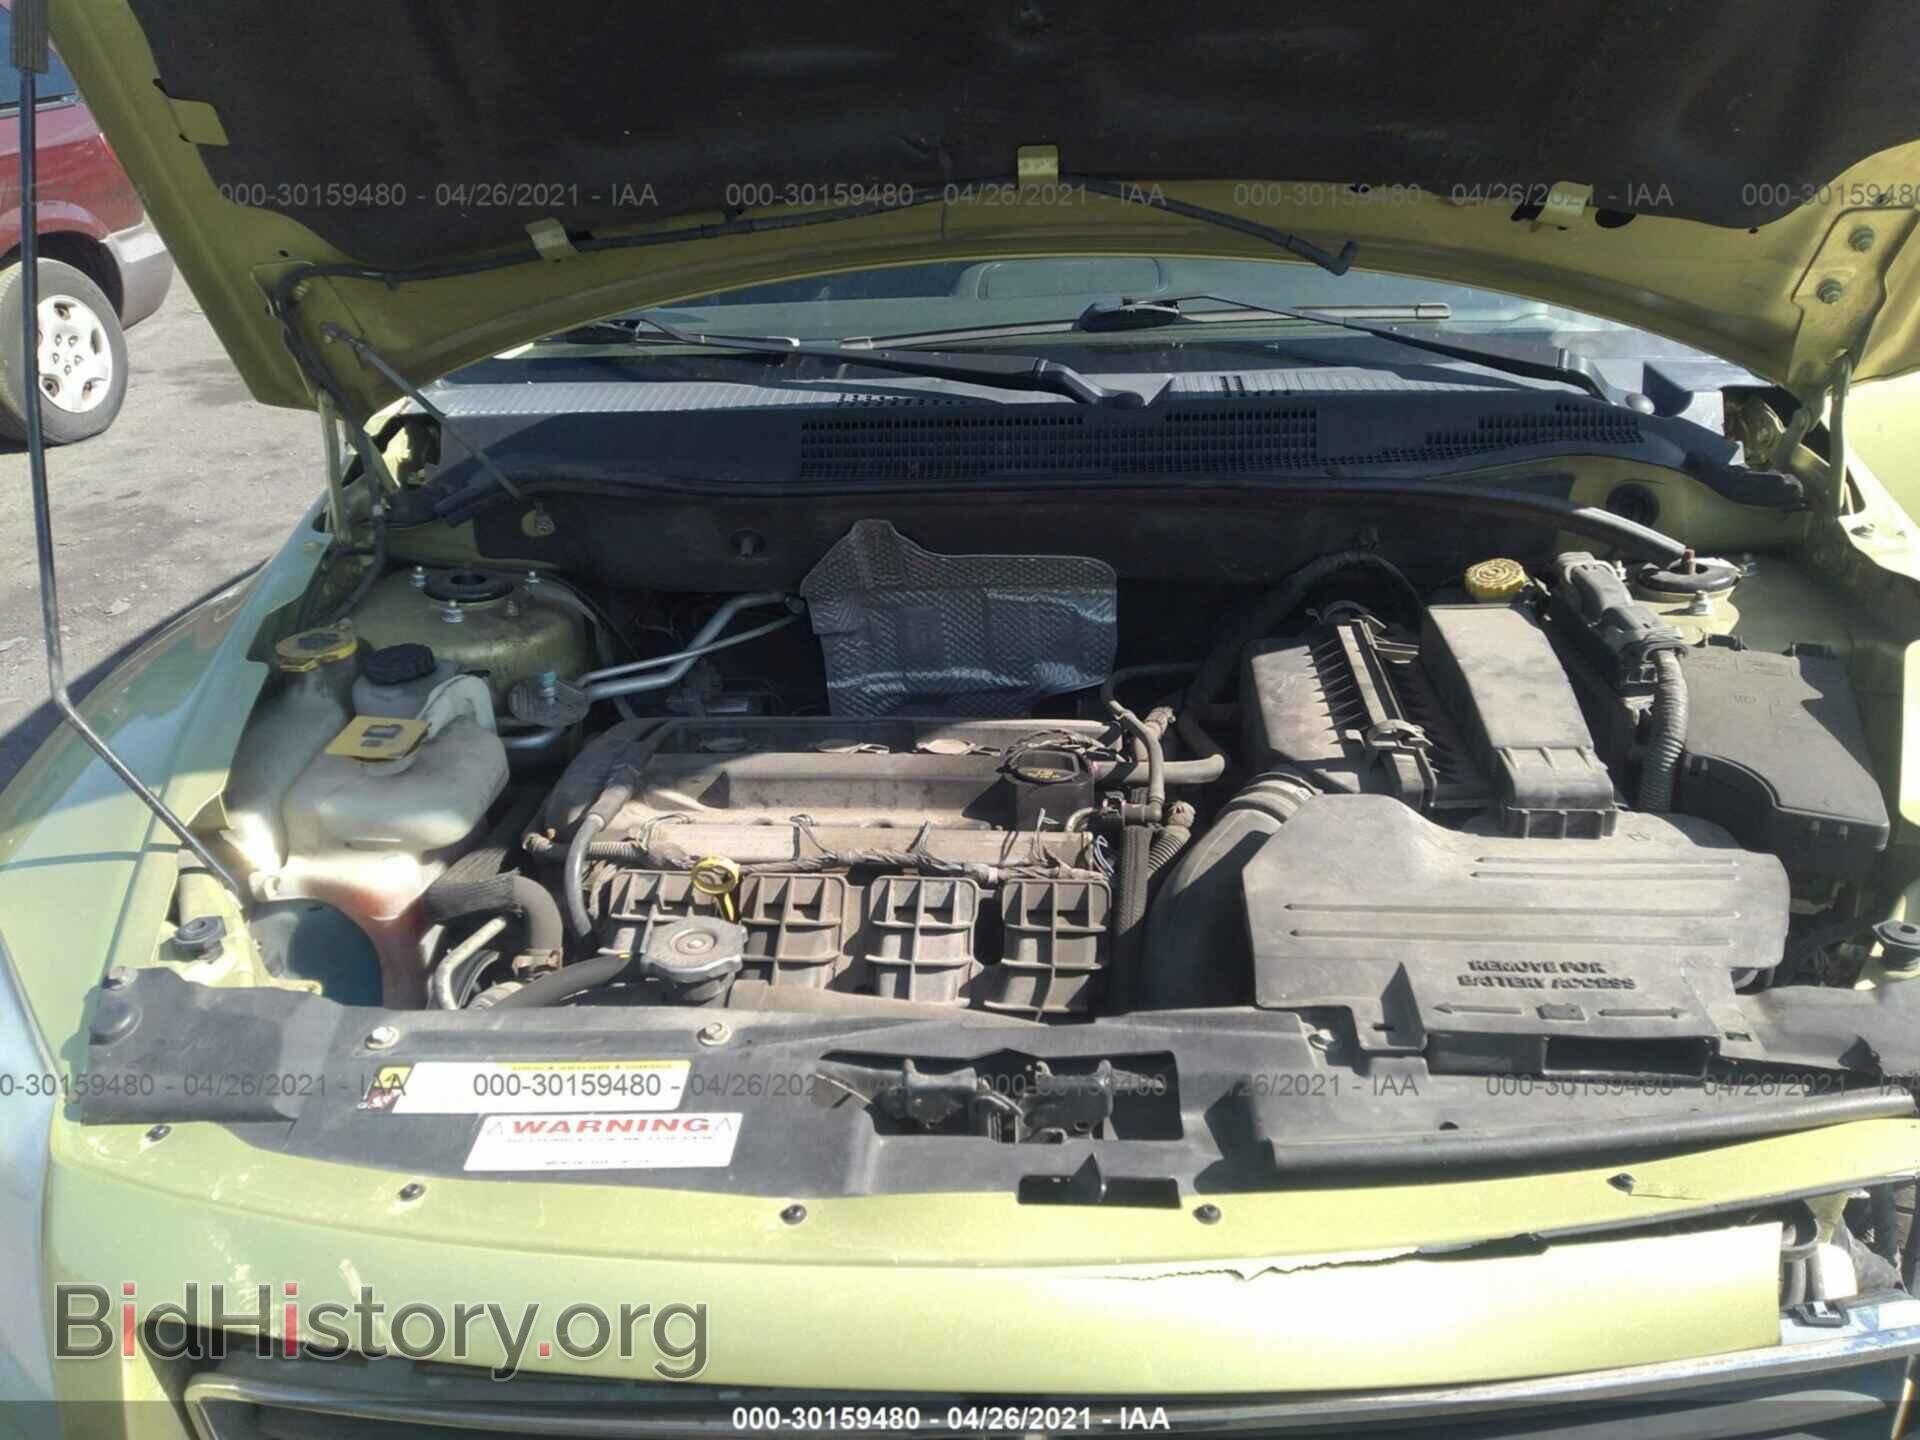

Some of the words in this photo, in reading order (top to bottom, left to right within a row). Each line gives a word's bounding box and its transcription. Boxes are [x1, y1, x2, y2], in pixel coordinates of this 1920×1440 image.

[1467, 960, 1558, 973] REMOVE
[1559, 961, 1607, 974] FOR
[1457, 975, 1545, 989] BATTERY
[1551, 977, 1637, 990] ACCESS
[512, 1116, 711, 1134] WARNING
